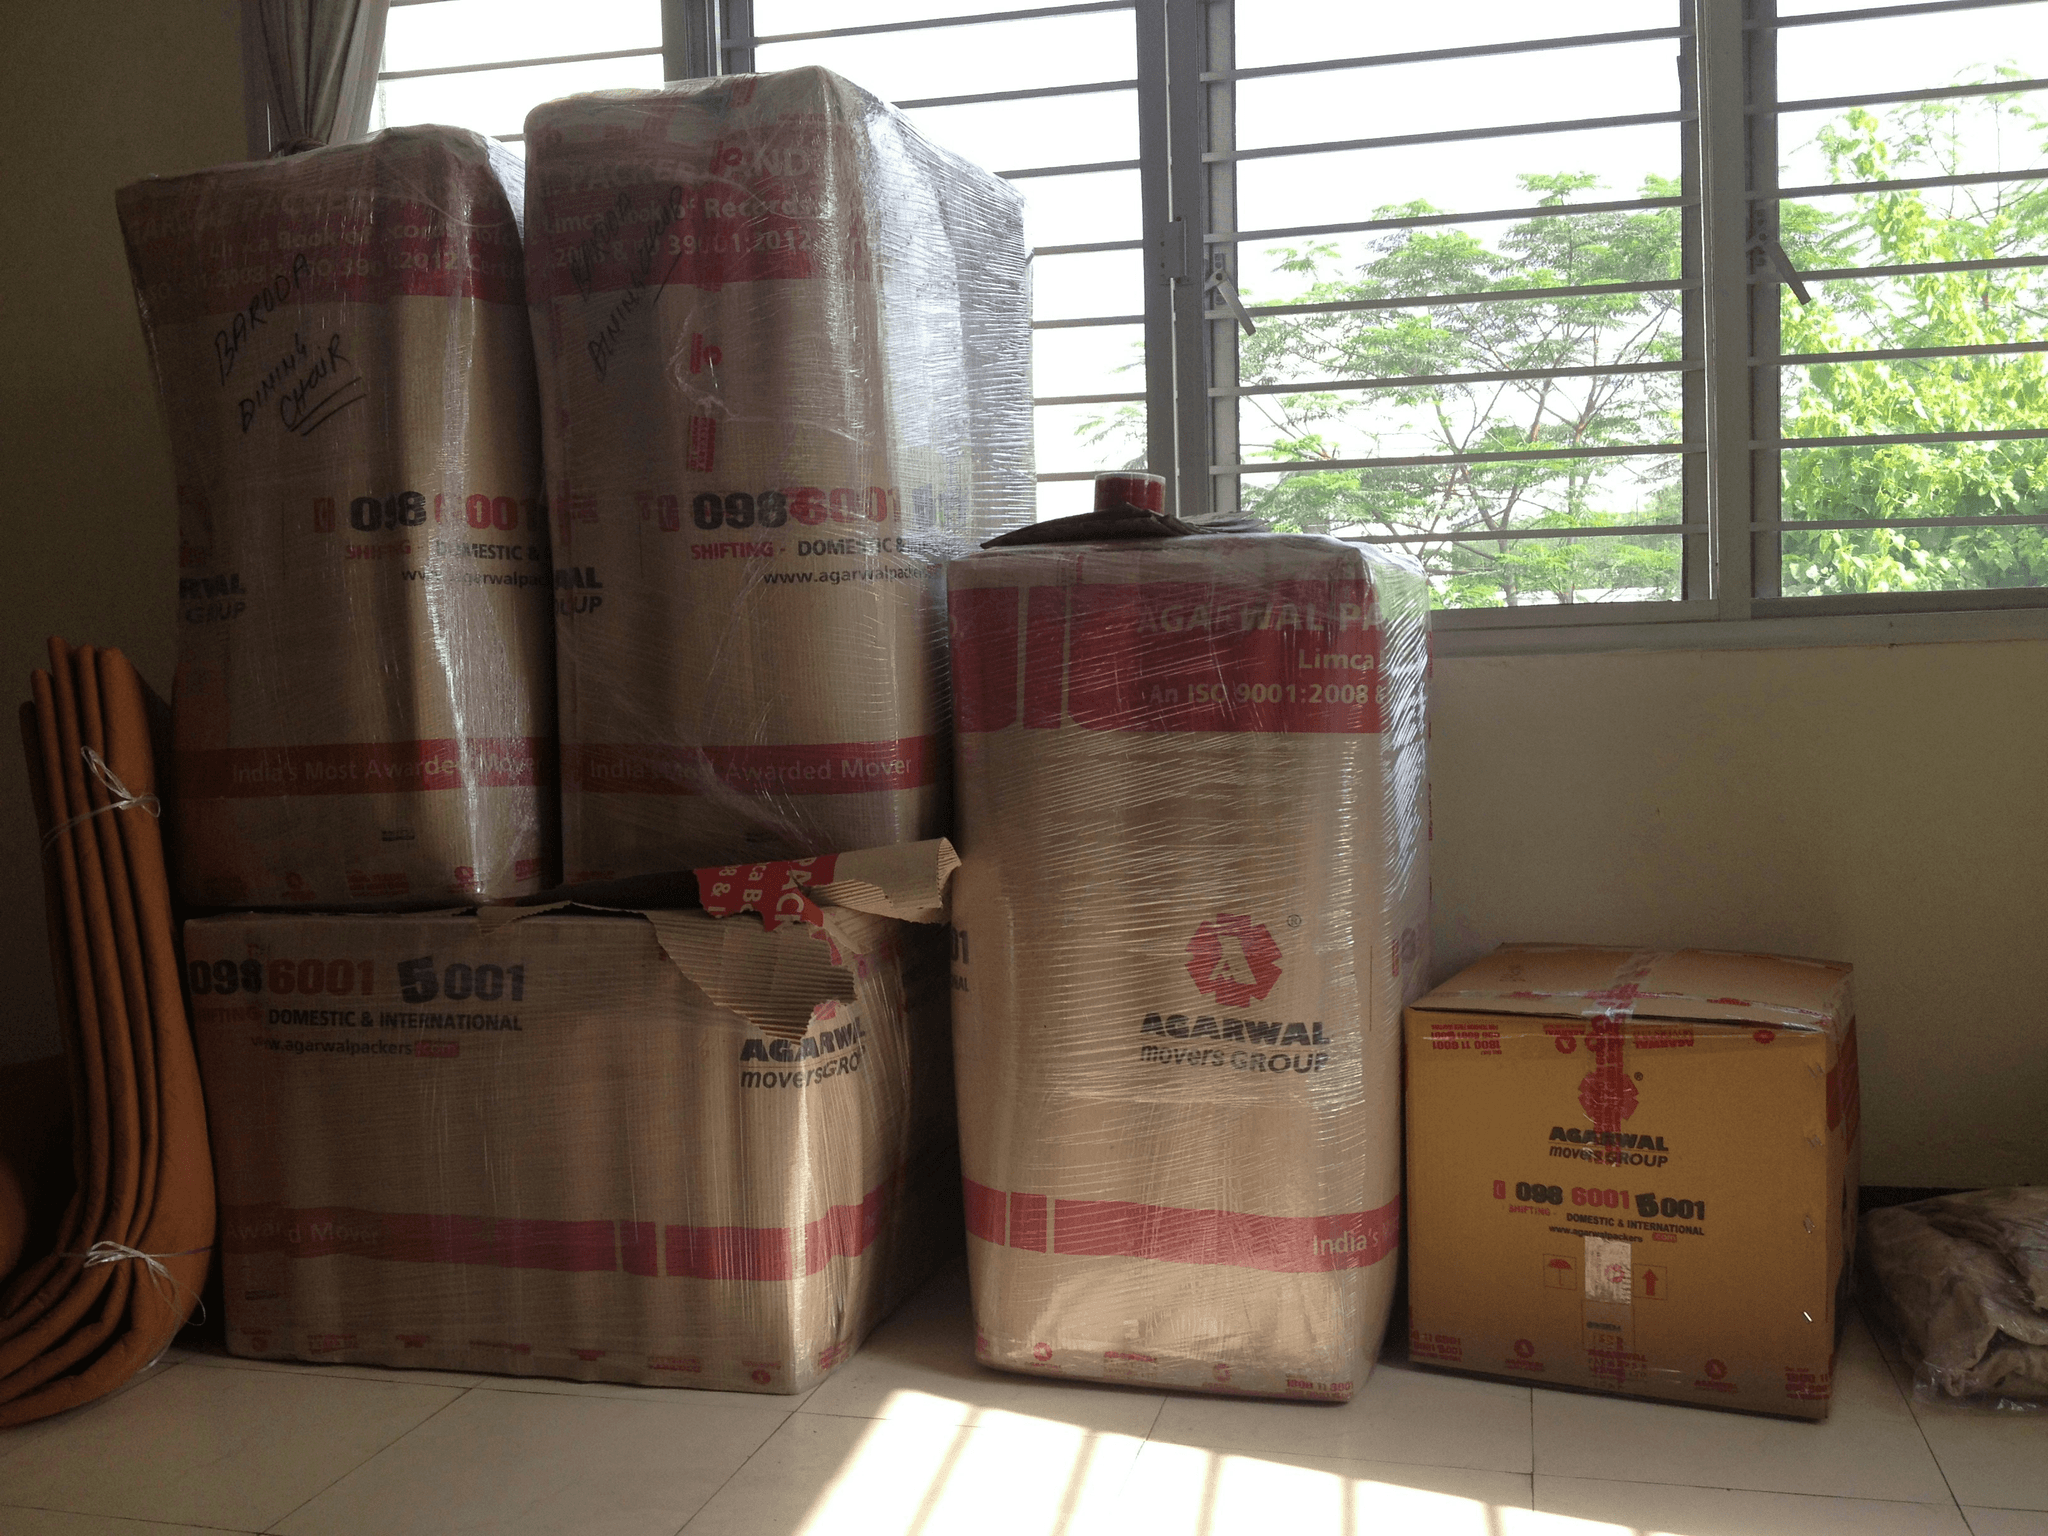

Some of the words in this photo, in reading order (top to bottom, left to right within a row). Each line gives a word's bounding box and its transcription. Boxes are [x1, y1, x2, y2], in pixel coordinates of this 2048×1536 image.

[214, 252, 312, 386] BARODA
[692, 491, 787, 530] 098
[691, 542, 774, 561] SHIFTING
[1299, 648, 1376, 671] Limca
[1236, 682, 1371, 706] 9001:2008
[841, 754, 912, 779] Mover
[266, 958, 376, 996] 6001
[397, 955, 526, 1004] 5001
[267, 1007, 356, 1028] DOMESTIC
[360, 1011, 374, 1029] &
[379, 1011, 523, 1032] INTERNATIONAL
[1140, 1012, 1332, 1046] AGARWAL
[1140, 1043, 1226, 1068] movers
[1230, 1051, 1331, 1075] GROUP
[1548, 1126, 1669, 1152] AGARWAL
[1515, 1182, 1564, 1206] 098
[1571, 1186, 1630, 1210] 6001
[1634, 1192, 1705, 1221] 5001
[1566, 1212, 1615, 1228] DOMESTIC
[1617, 1218, 1625, 1228] &
[1627, 1219, 1705, 1236] INTERNATIONAL
[1312, 1226, 1379, 1257] India's
